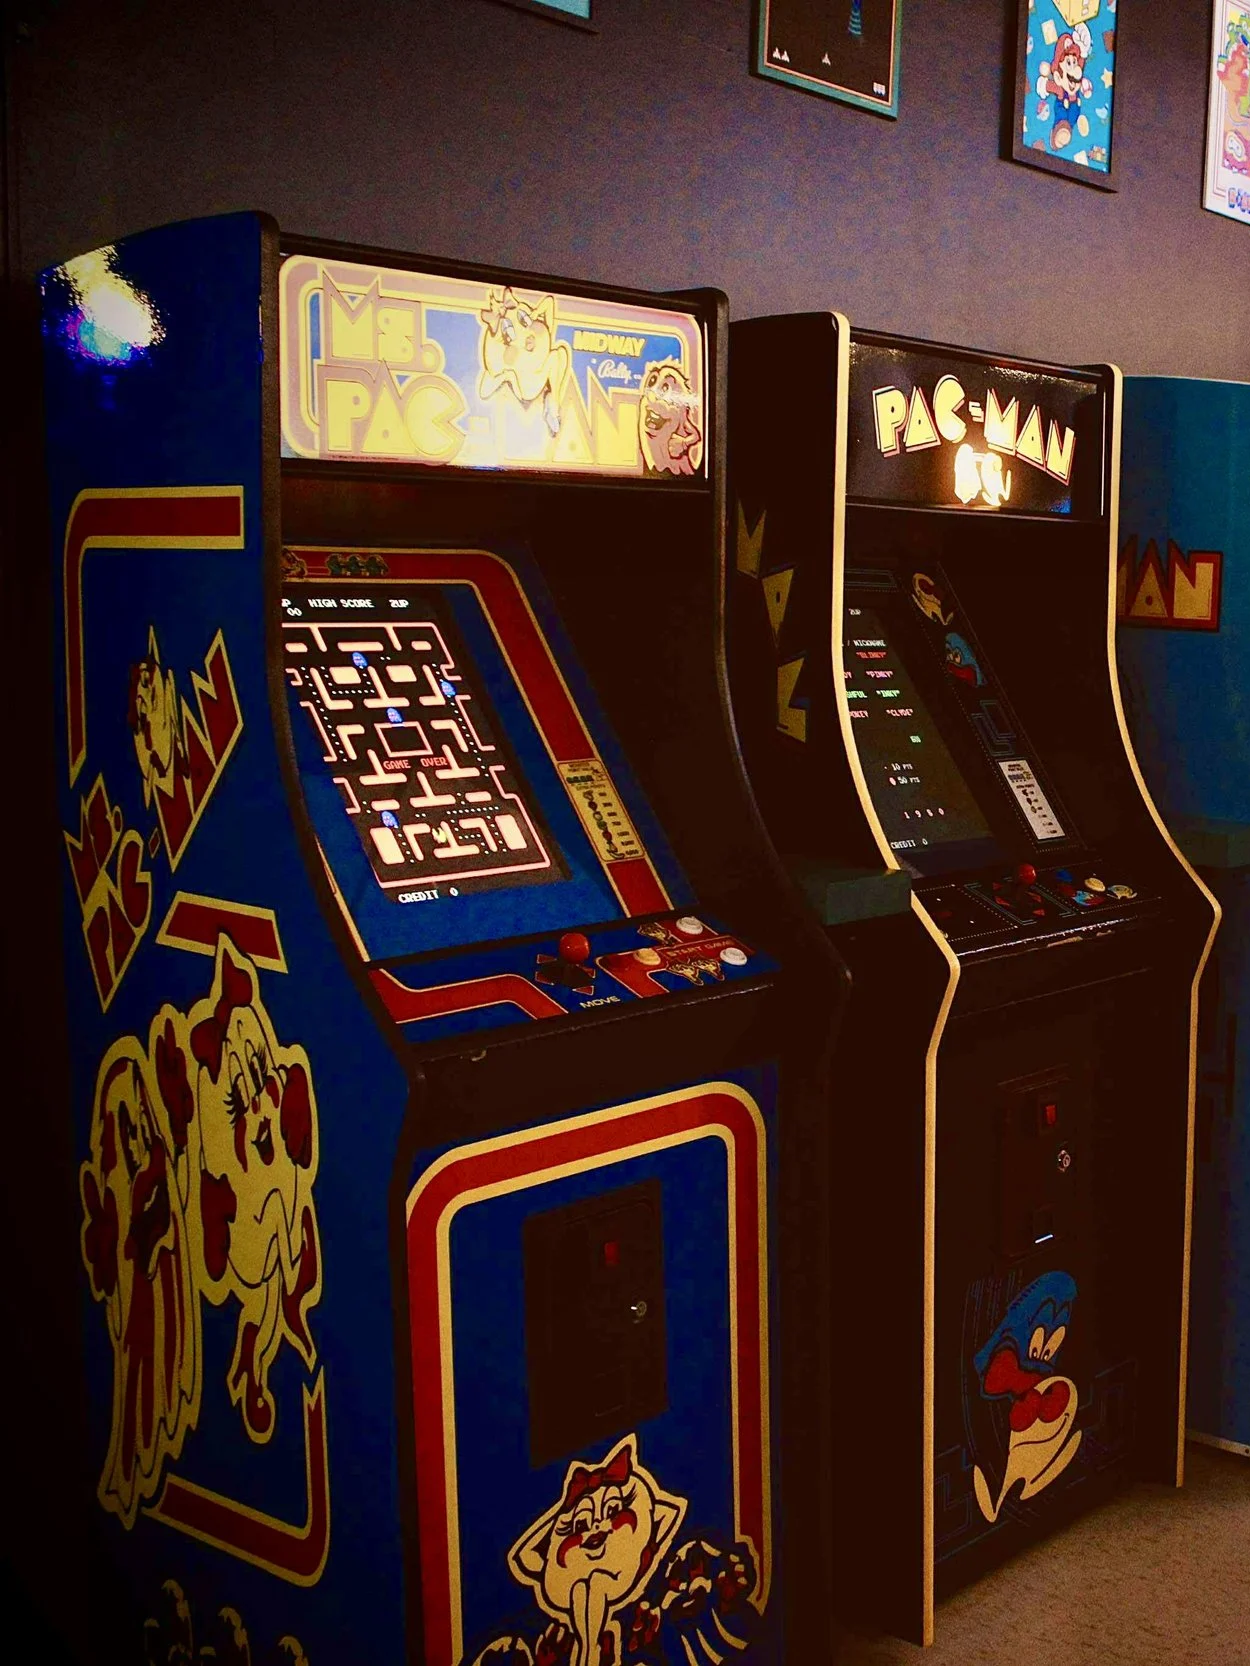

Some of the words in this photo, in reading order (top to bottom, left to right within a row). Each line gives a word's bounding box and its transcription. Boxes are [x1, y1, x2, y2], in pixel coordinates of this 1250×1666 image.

[572, 330, 645, 357] MIDWAY
[320, 362, 640, 467] PAC-MAN
[873, 374, 1076, 486] PAC-MAN
[307, 598, 338, 608] HIGH
[340, 598, 375, 608] SCORE
[388, 599, 409, 608] 2UP
[383, 759, 412, 770] GAME
[420, 756, 448, 767] OVER
[890, 839, 916, 849] CREDIT
[921, 838, 929, 846] 0
[398, 889, 439, 904] CREDIT
[449, 887, 459, 897] 0
[579, 995, 621, 1009] MOVE
